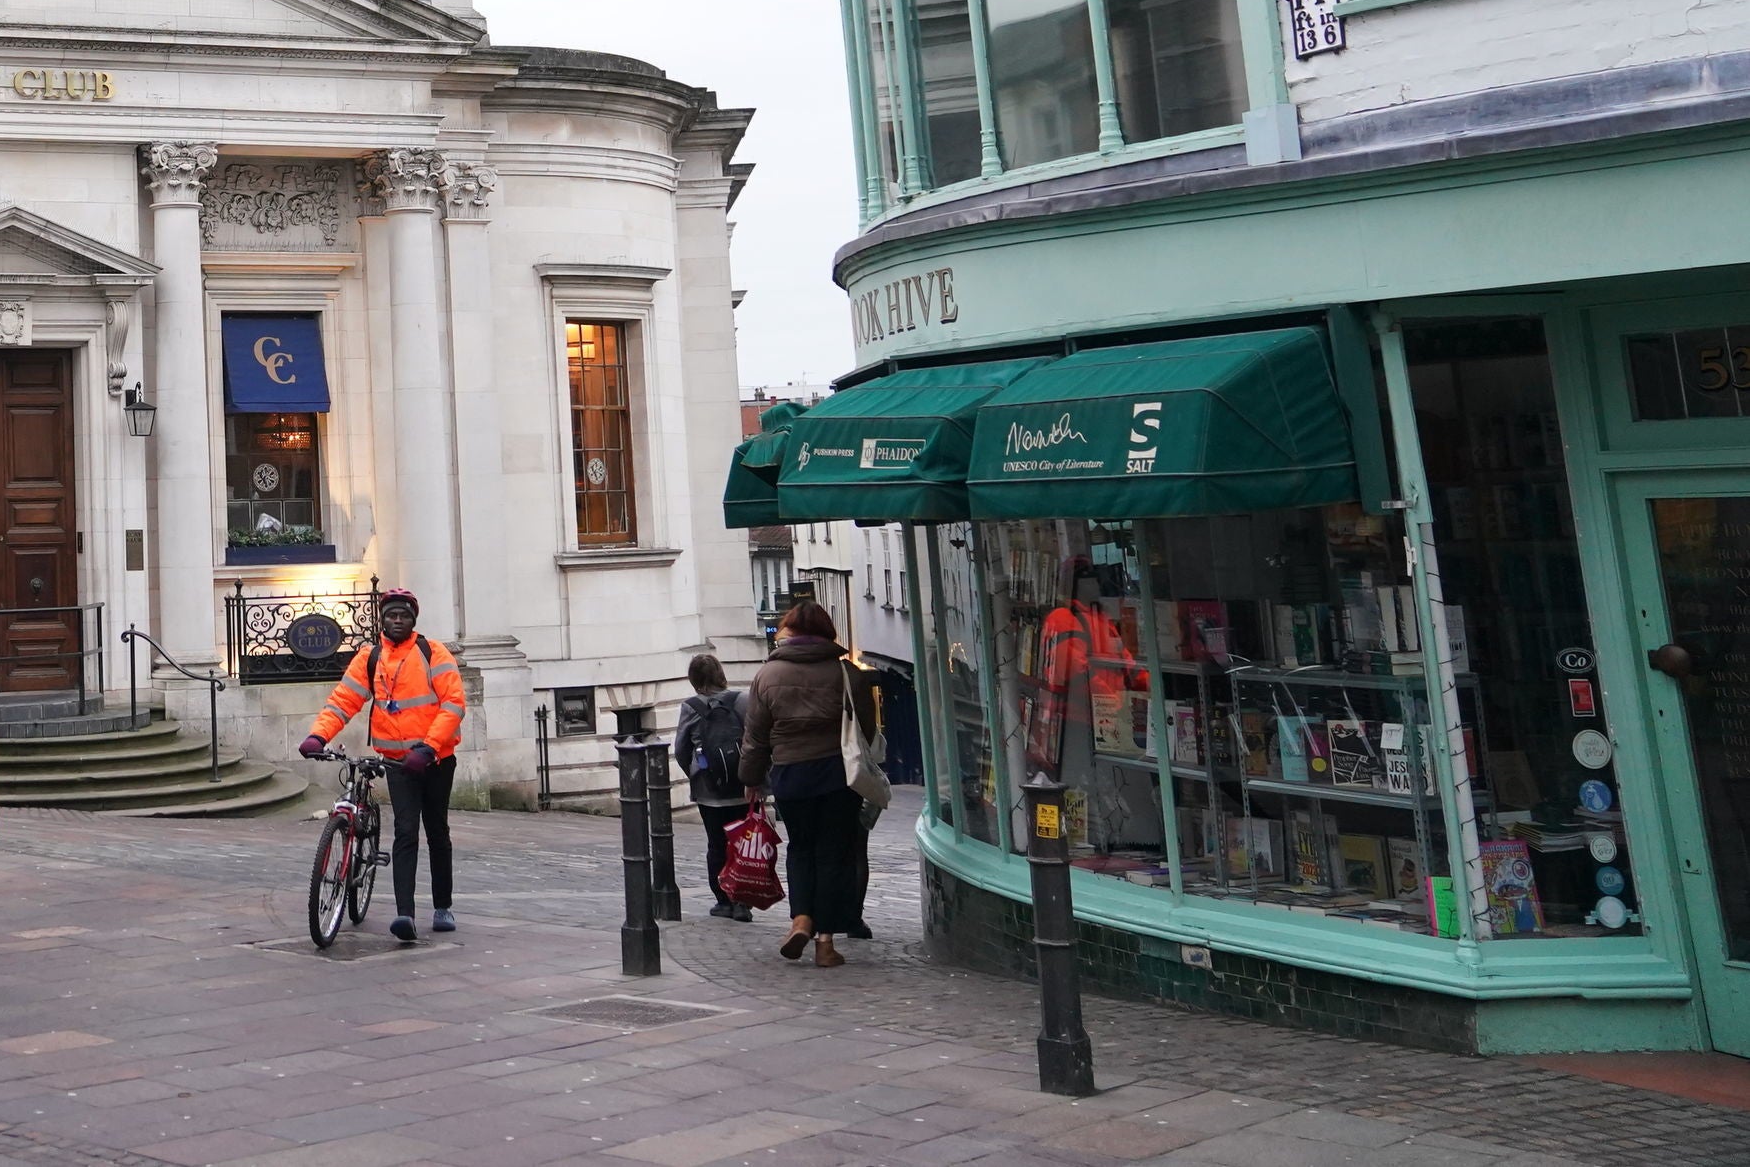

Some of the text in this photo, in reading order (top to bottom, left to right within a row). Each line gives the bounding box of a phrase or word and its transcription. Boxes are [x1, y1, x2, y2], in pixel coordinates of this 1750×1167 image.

[1296, 7, 1338, 31] ft in
[1299, 24, 1337, 52] 13 6
[13, 69, 117, 102] CLUB
[884, 267, 959, 336] HIVE
[813, 448, 855, 457] PUSHKIN PRESS
[1003, 458, 1104, 472] UNESCO City of Literature
[1125, 459, 1155, 474] SALT
[298, 625, 331, 637] COSY
[298, 637, 331, 648] CLUB
